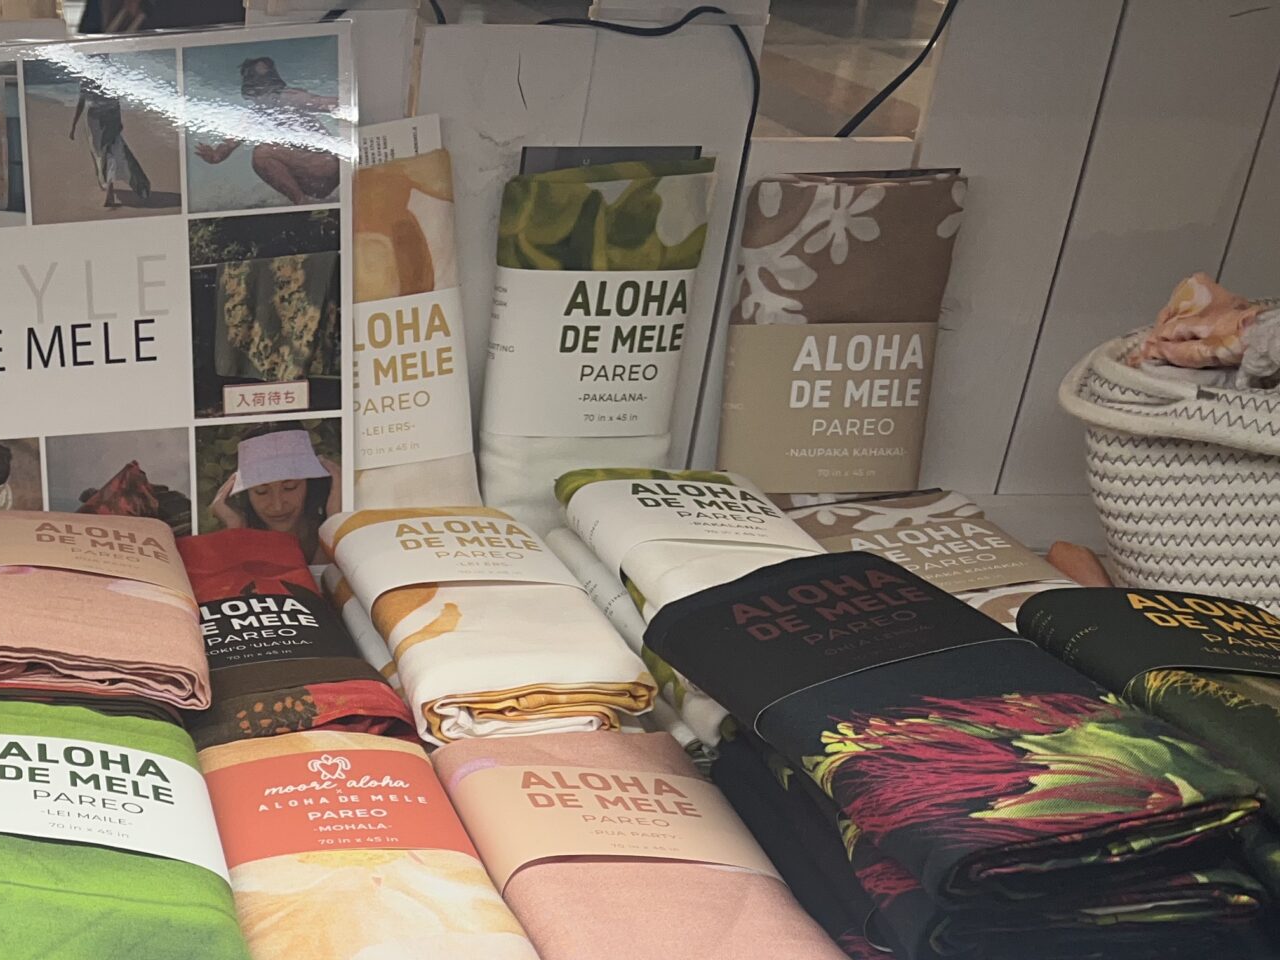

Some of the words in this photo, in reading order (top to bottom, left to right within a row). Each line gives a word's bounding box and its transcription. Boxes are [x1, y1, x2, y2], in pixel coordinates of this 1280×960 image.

[563, 279, 688, 317] ALOHA
[26, 318, 157, 370] MELE
[559, 325, 601, 354] DE
[611, 323, 685, 354] MELE
[792, 334, 924, 372] ALOHA
[373, 346, 454, 386] MELE
[580, 363, 658, 382] PAREO
[236, 389, 296, 408] 入荷待ち
[789, 380, 833, 409] DE
[844, 379, 922, 408] MELE
[583, 413, 595, 422] 70
[597, 413, 606, 422] in
[615, 414, 628, 422] 45
[629, 412, 638, 421] in
[811, 418, 895, 436] PAREO
[631, 482, 769, 505] ALOHA
[637, 497, 684, 509] DE
[698, 498, 782, 519] MELE
[676, 511, 766, 524] PAREO
[35, 522, 166, 552] ALOHA
[395, 519, 533, 539] ALOHA
[850, 522, 994, 552] ALOHA
[36, 533, 76, 545] DE
[90, 538, 170, 564] MELE
[400, 536, 445, 550] DE
[459, 535, 543, 552] MELE
[919, 536, 1012, 558] MELE
[71, 547, 141, 563] PAREO
[435, 551, 524, 560] PAREO
[904, 553, 997, 572] PAREO
[731, 568, 908, 625] ALOHA
[232, 613, 319, 631] MELE
[746, 614, 811, 641] DE
[815, 586, 934, 622] MELE
[1144, 612, 1210, 630] DE
[207, 628, 297, 647] PAREO
[803, 610, 918, 645] PAREO
[70, 770, 174, 805] MELE
[264, 780, 338, 797] moore
[347, 775, 411, 789] aloha
[521, 770, 689, 799] ALOHA
[33, 789, 144, 814] PAREO
[258, 796, 330, 812] ALOHA
[338, 794, 359, 803] DE
[370, 794, 429, 804] MELE
[526, 792, 583, 809] DE
[593, 793, 703, 819] MELE
[77, 811, 133, 826] MAILE-
[307, 808, 388, 821] PAREO
[582, 814, 670, 828] PAREO
[69, 823, 83, 831] in
[97, 828, 114, 836] 45
[117, 830, 130, 839] in
[313, 823, 393, 833] -MOHALA-
